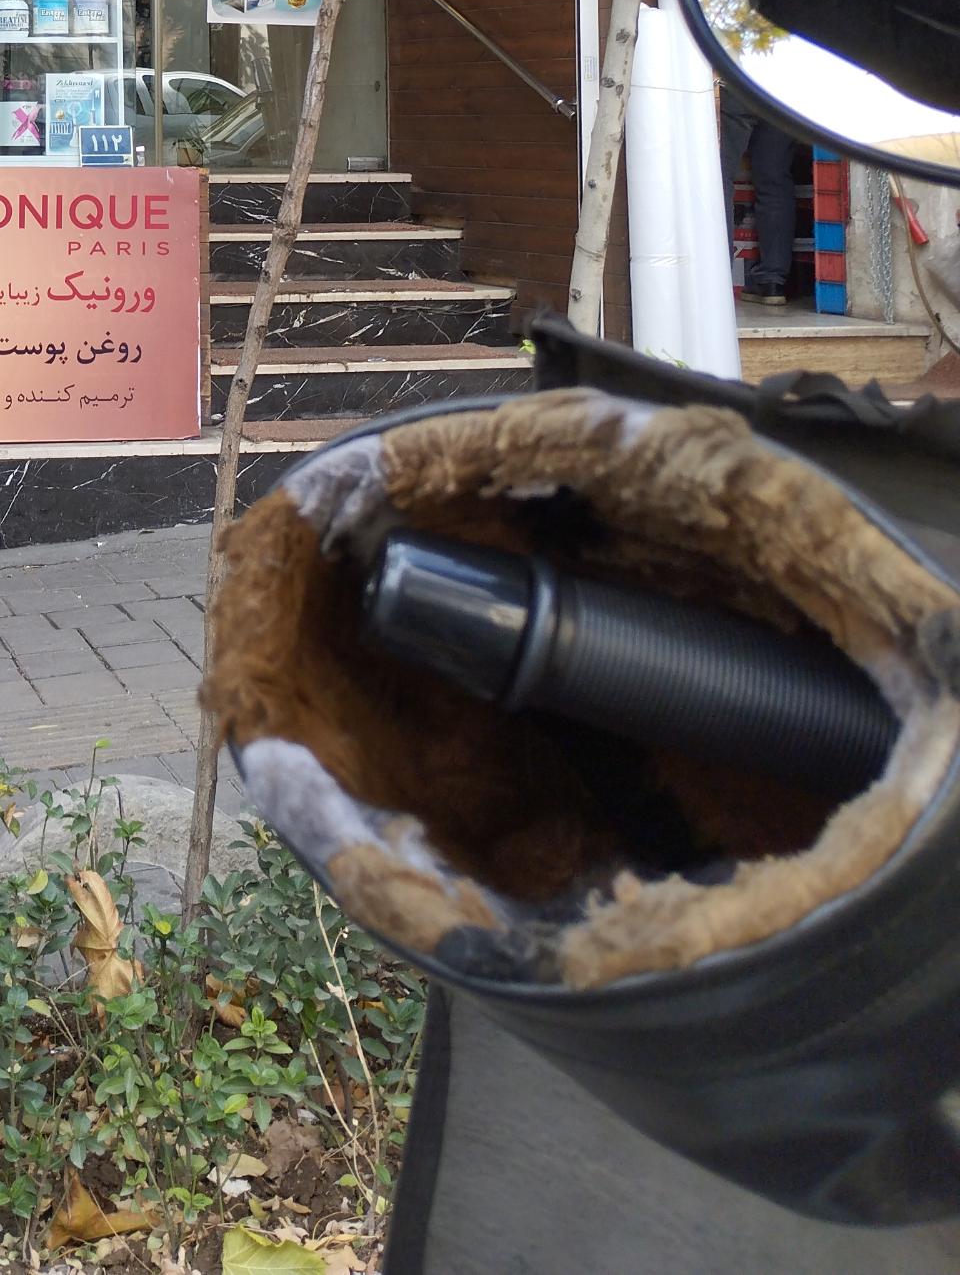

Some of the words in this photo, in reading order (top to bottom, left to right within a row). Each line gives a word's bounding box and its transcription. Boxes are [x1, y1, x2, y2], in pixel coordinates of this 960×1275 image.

[91, 134, 123, 152] ۱۱۲
[67, 241, 170, 256] PARIS
[46, 270, 156, 313] ورونیک
[76, 330, 143, 365] روغن
[4, 391, 13, 410] و
[16, 384, 76, 405] کننده
[78, 386, 135, 409] ترمیم
